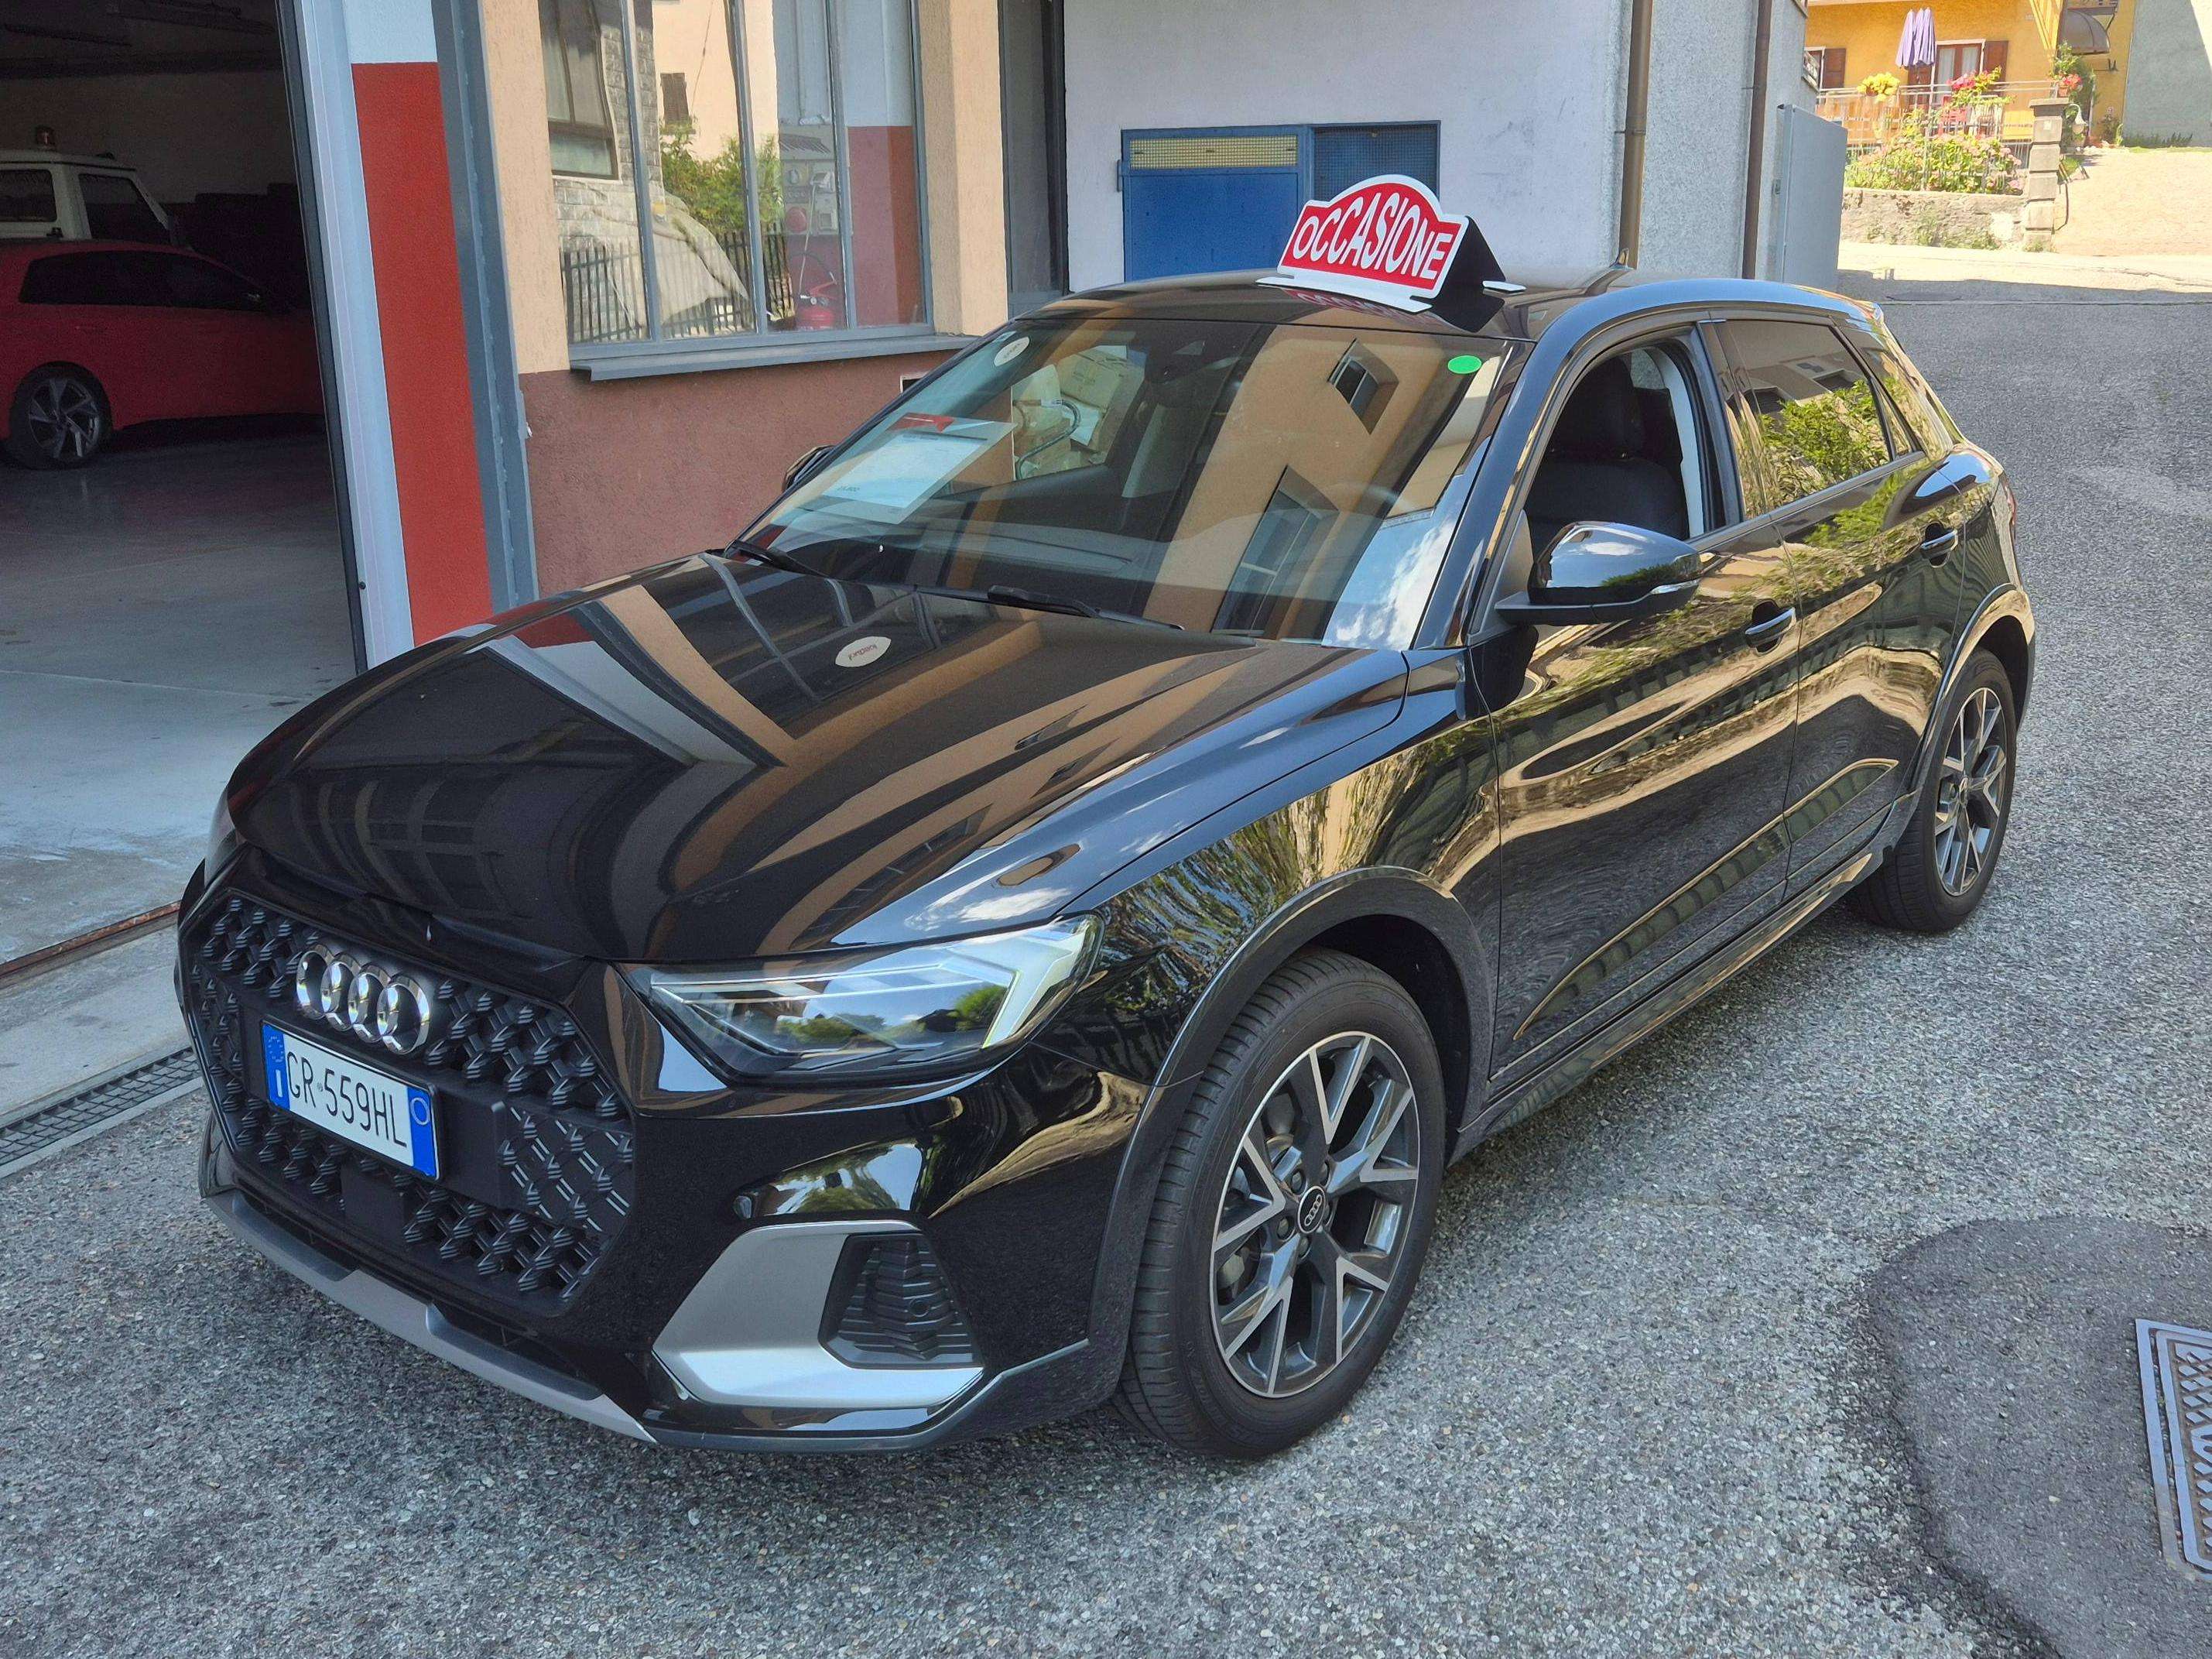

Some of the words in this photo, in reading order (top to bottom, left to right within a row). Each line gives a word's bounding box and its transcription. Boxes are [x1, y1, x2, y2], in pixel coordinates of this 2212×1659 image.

[1293, 192, 1453, 280] OCCASIONE
[286, 1051, 317, 1109] GR
[324, 1068, 407, 1148] 559HL
